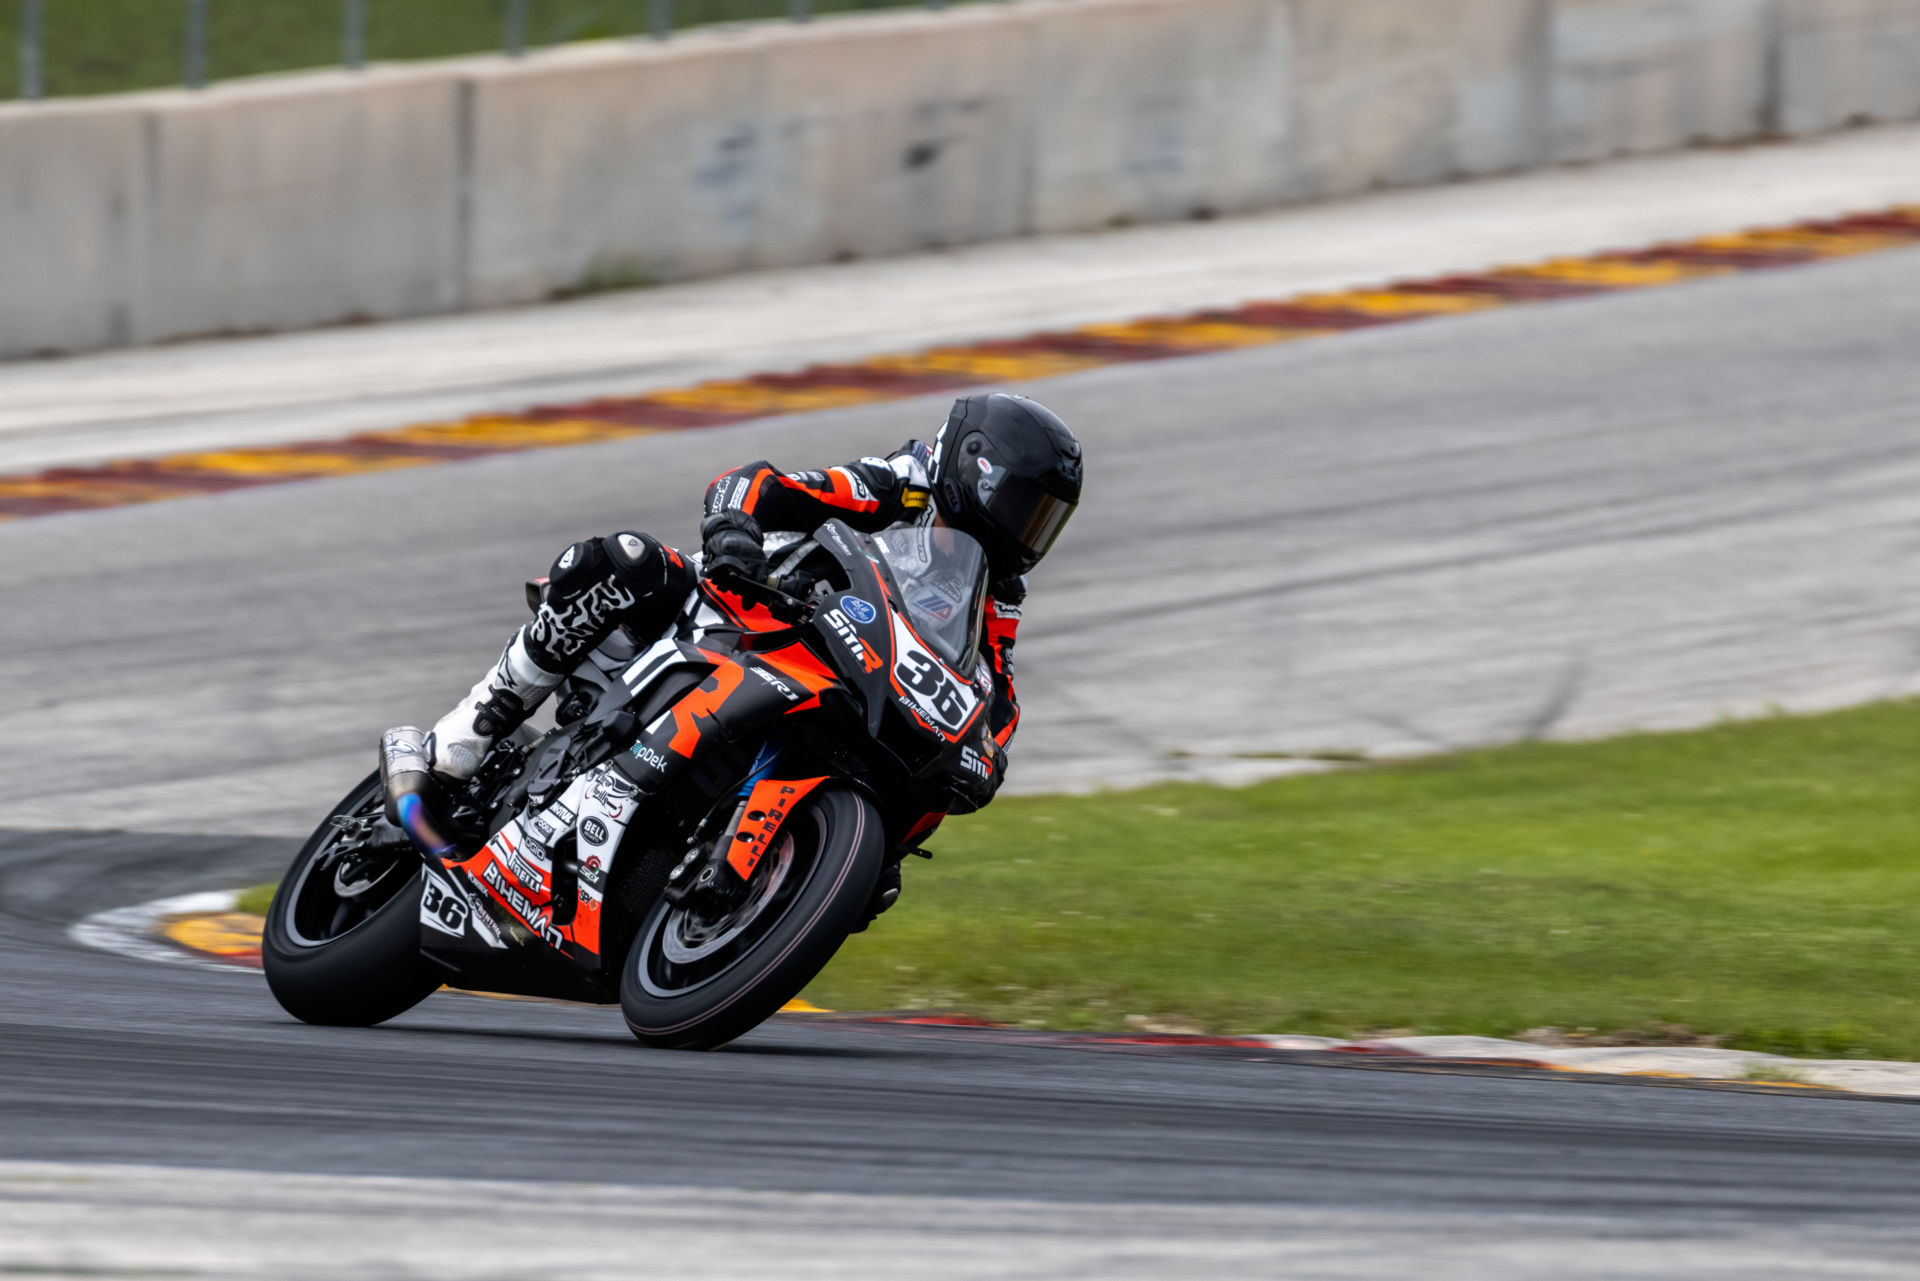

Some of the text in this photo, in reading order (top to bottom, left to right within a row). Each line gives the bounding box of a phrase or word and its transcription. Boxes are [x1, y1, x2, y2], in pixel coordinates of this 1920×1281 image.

[749, 666, 800, 701] 36R1
[896, 649, 968, 726] 36
[549, 801, 575, 825] MOTUL
[583, 819, 605, 841] BELL
[746, 785, 796, 868] PIRELLI
[525, 836, 546, 861] OGIO
[507, 848, 544, 894] PIRELLI
[579, 864, 600, 884] SIDI
[423, 880, 467, 930] 36
